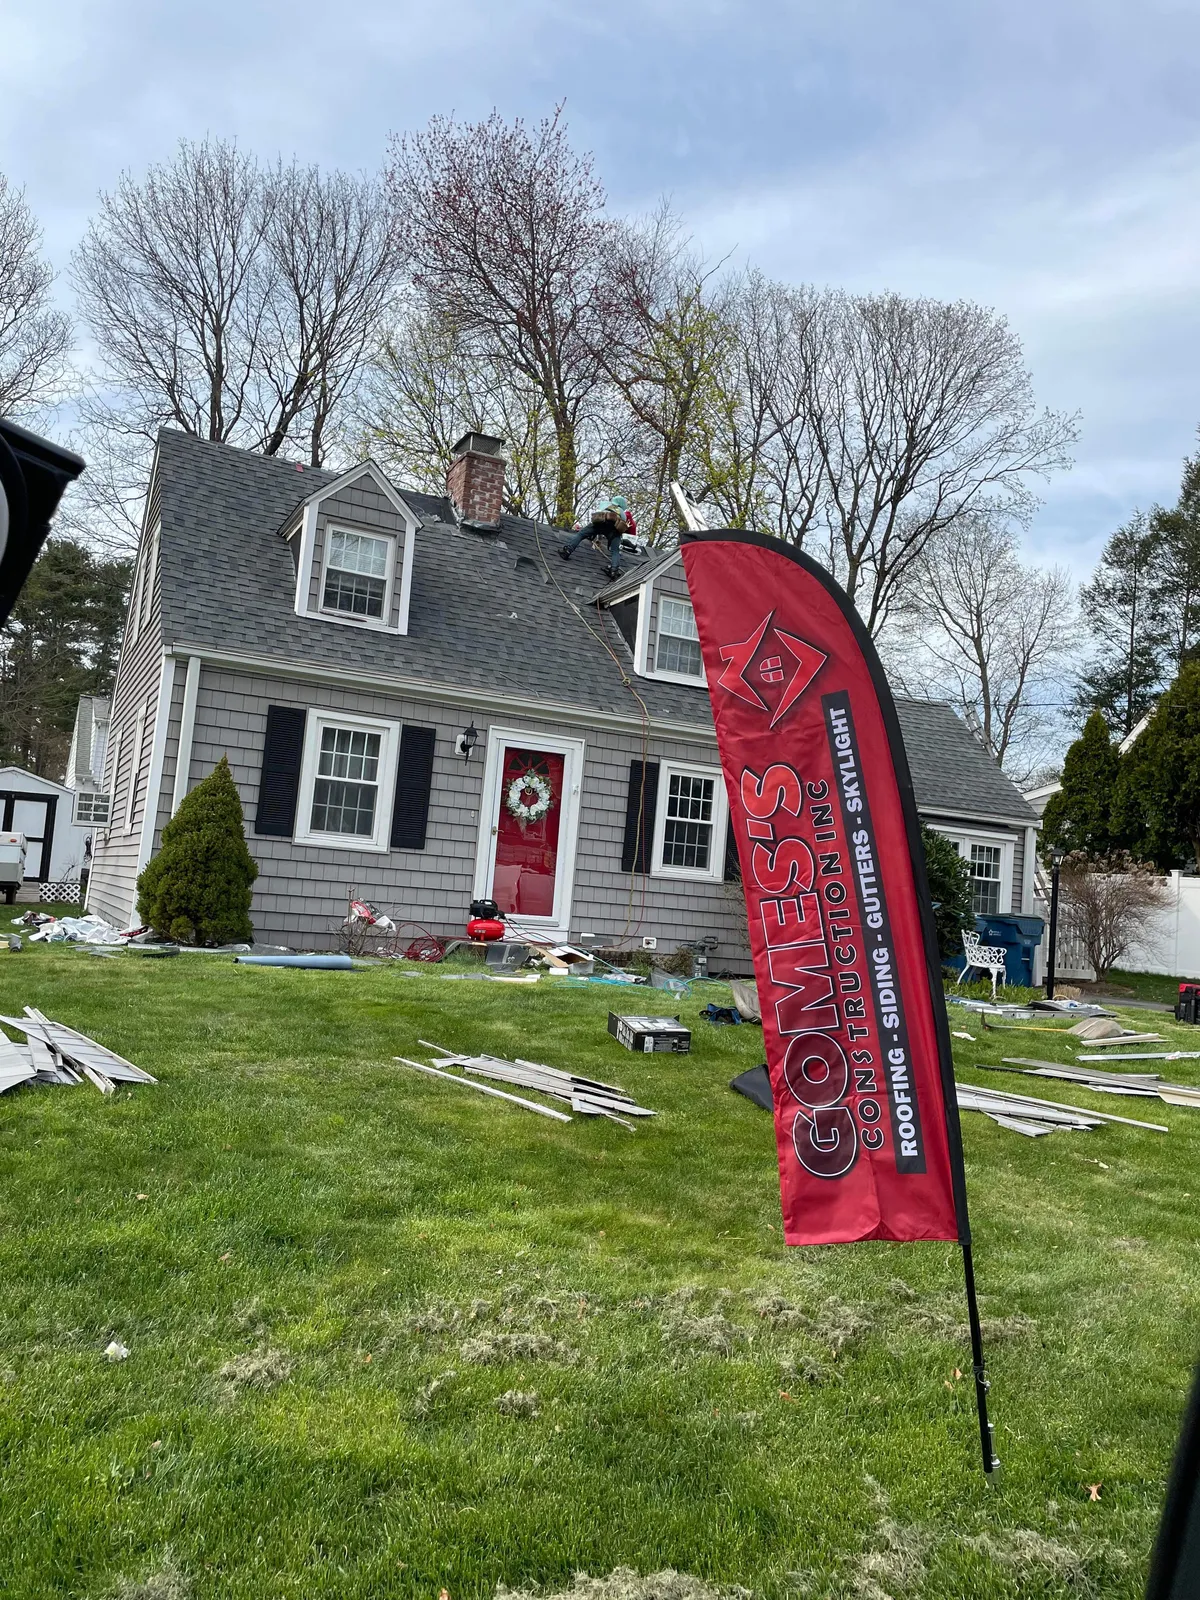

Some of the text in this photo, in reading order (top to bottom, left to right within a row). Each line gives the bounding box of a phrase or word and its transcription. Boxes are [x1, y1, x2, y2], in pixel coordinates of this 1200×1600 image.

[829, 707, 863, 813] SKYLIGHT
[852, 829, 889, 929] GUTTERS
[740, 763, 858, 1177] GOMES'S
[806, 778, 884, 1151] CONSTRUCTION INC
[872, 947, 900, 1030] SIDING
[888, 1047, 919, 1158] ROOFING
